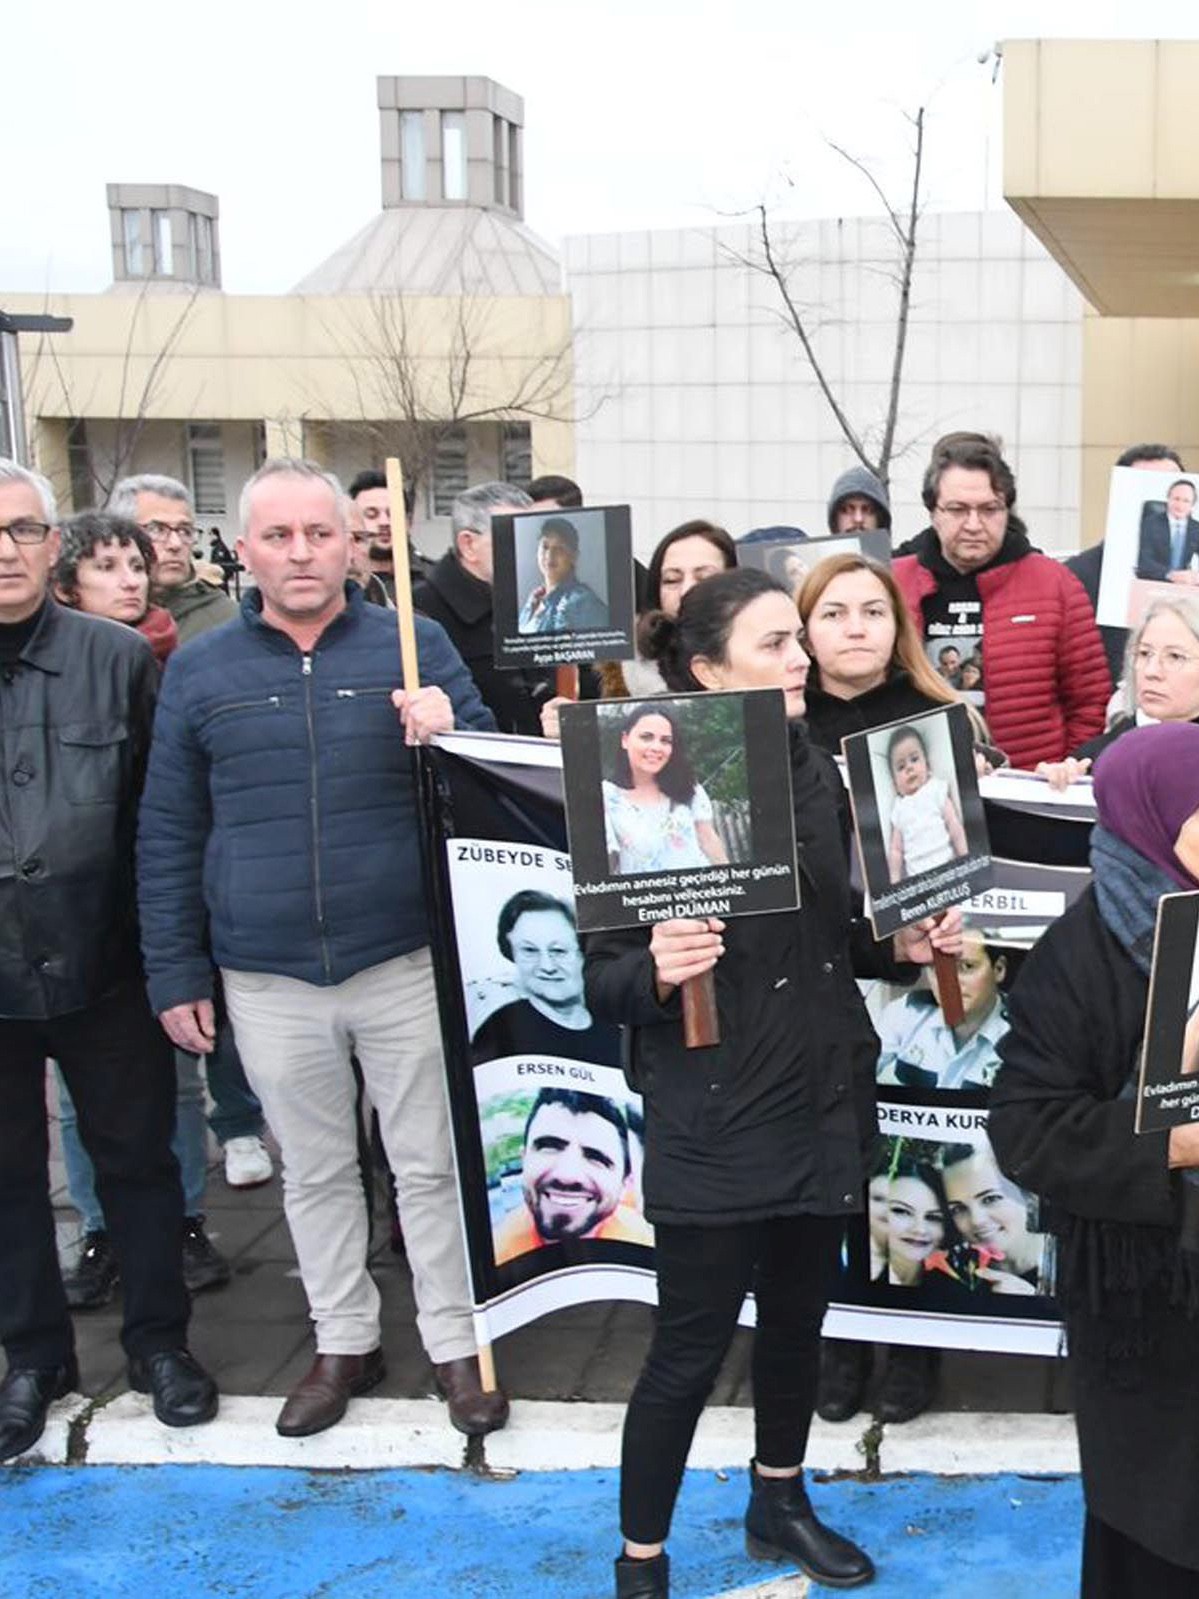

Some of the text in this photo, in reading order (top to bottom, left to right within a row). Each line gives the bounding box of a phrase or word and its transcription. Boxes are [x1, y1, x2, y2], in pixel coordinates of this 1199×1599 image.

[457, 843, 544, 868] ZÜBEYDE
[574, 864, 791, 896] Evladımın annesiz geçirdiği her günün
[622, 891, 672, 907] hesabını
[900, 902, 927, 921] Beren
[926, 881, 972, 911] KURTULUŞ
[638, 899, 731, 922] Emel DÜMAN
[516, 1062, 596, 1082] ERSEN GÜL
[1143, 1079, 1198, 1097] Evladımın
[1160, 1097, 1180, 1109] her
[877, 1107, 939, 1127] DERYA
